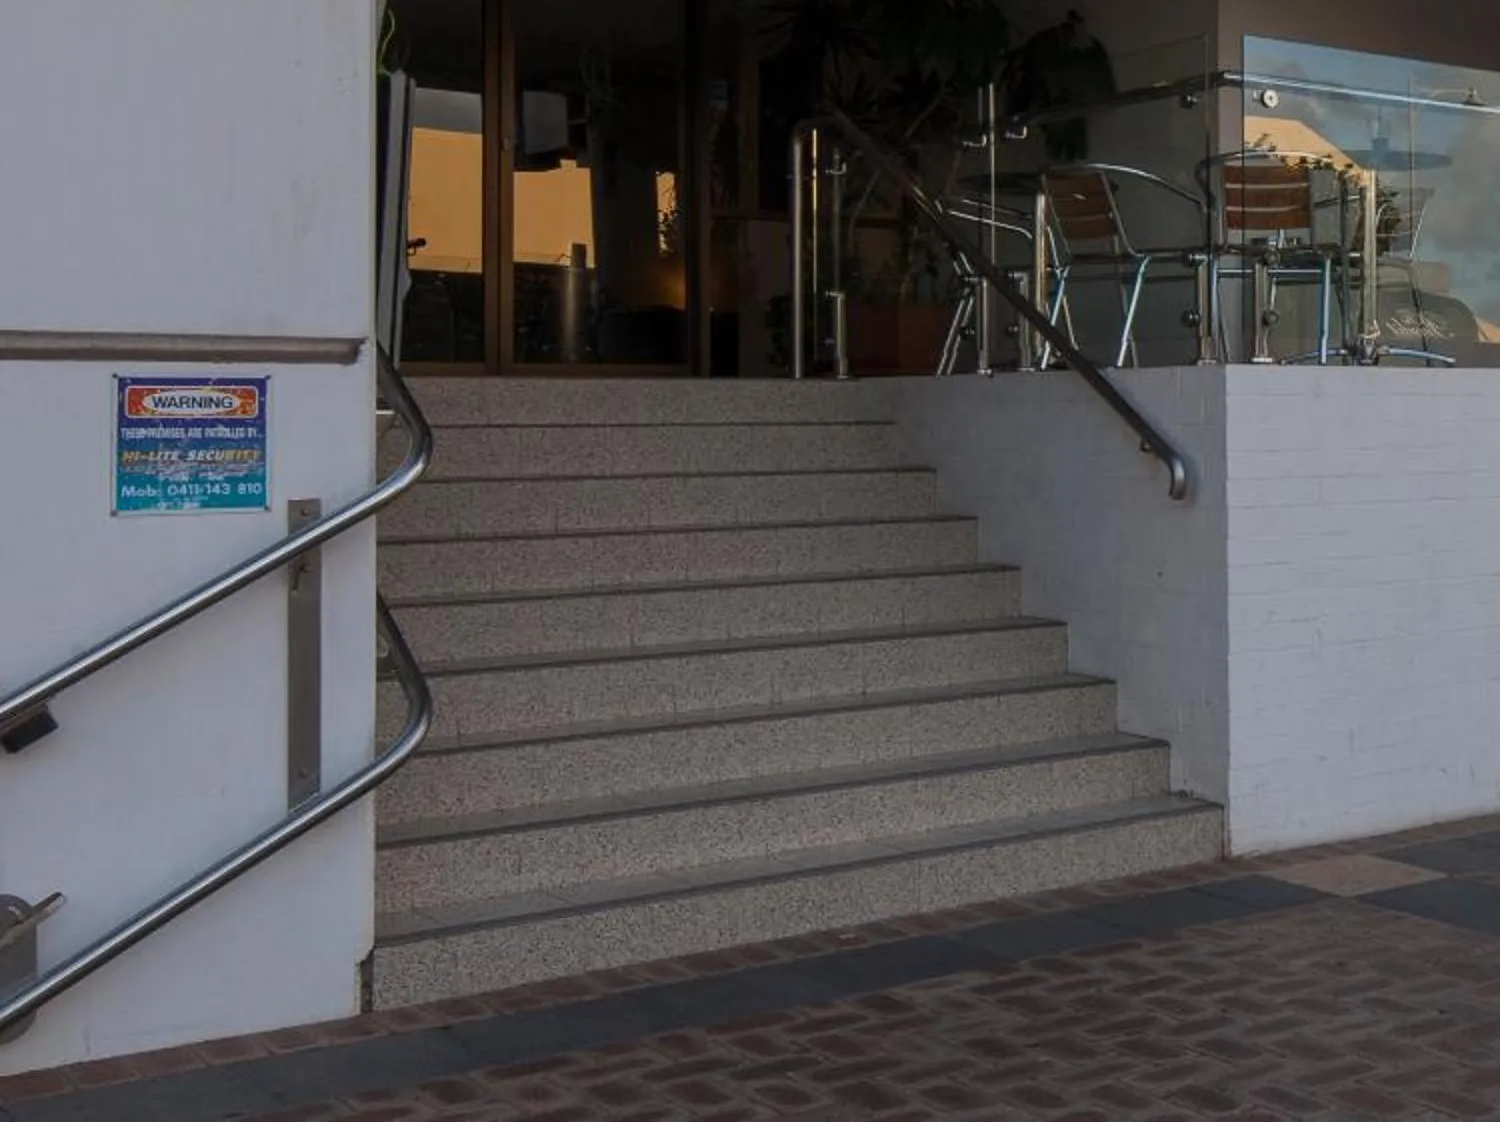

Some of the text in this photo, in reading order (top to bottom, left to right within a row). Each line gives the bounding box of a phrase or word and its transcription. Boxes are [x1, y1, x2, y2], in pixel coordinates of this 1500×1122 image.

[151, 395, 234, 410] WARNING
[184, 449, 258, 463] SECURITY
[121, 485, 162, 498] Mob:
[237, 483, 263, 496] 810
